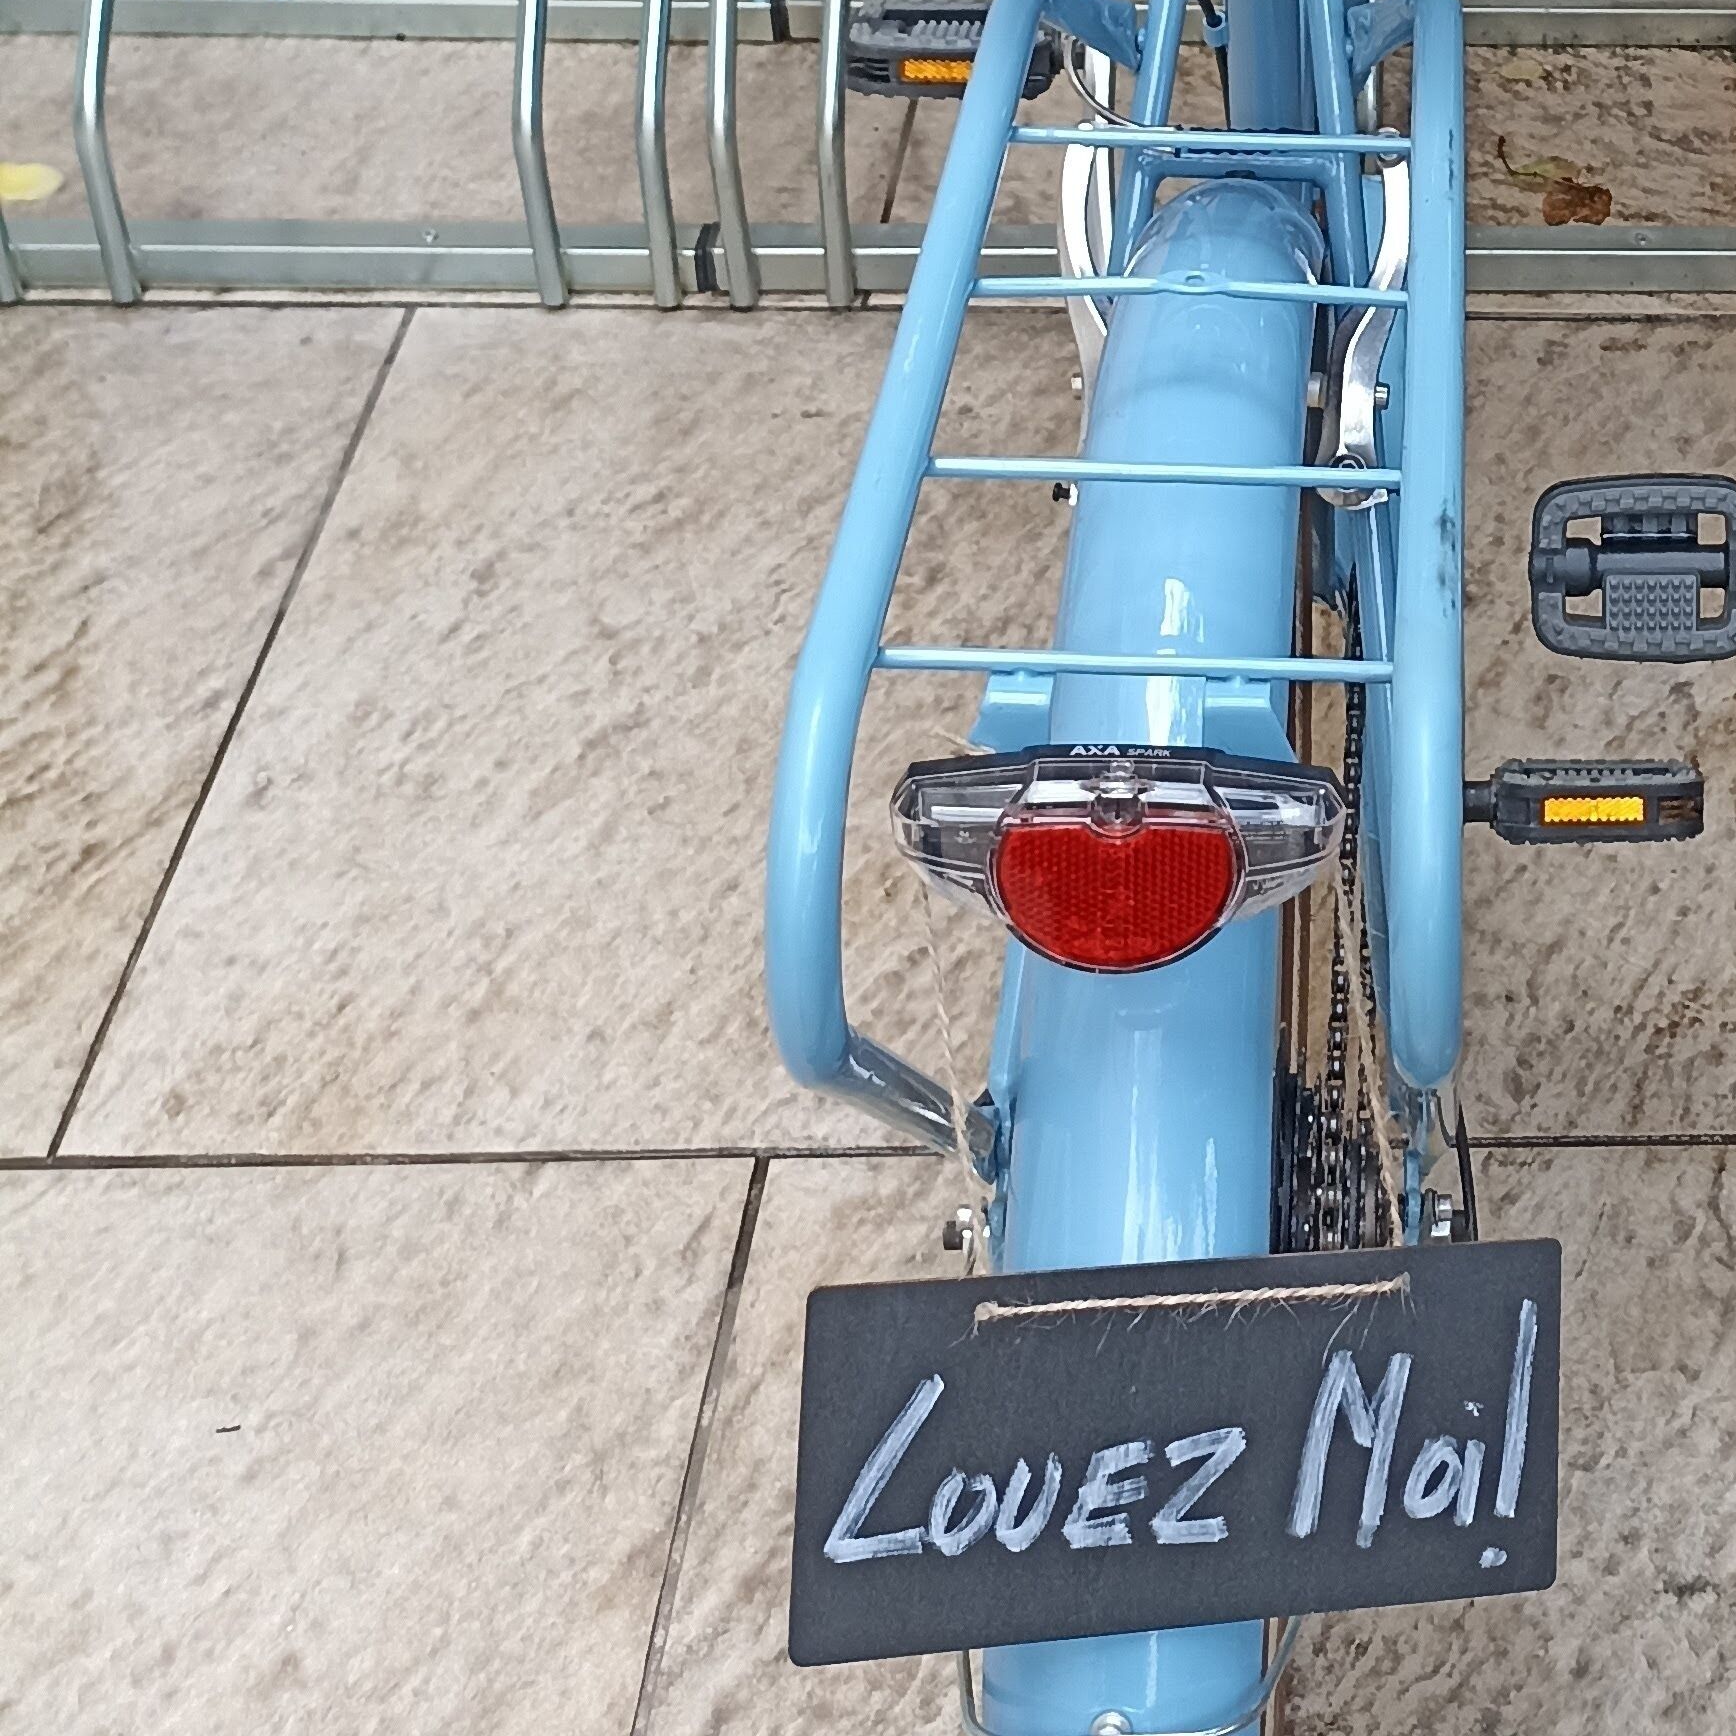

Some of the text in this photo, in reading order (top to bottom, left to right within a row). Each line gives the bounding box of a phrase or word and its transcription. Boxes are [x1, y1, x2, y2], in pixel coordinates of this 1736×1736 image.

[1069, 743, 1171, 757] AXA SPARK
[824, 1298, 1539, 1570] LOUEZ Moi!
